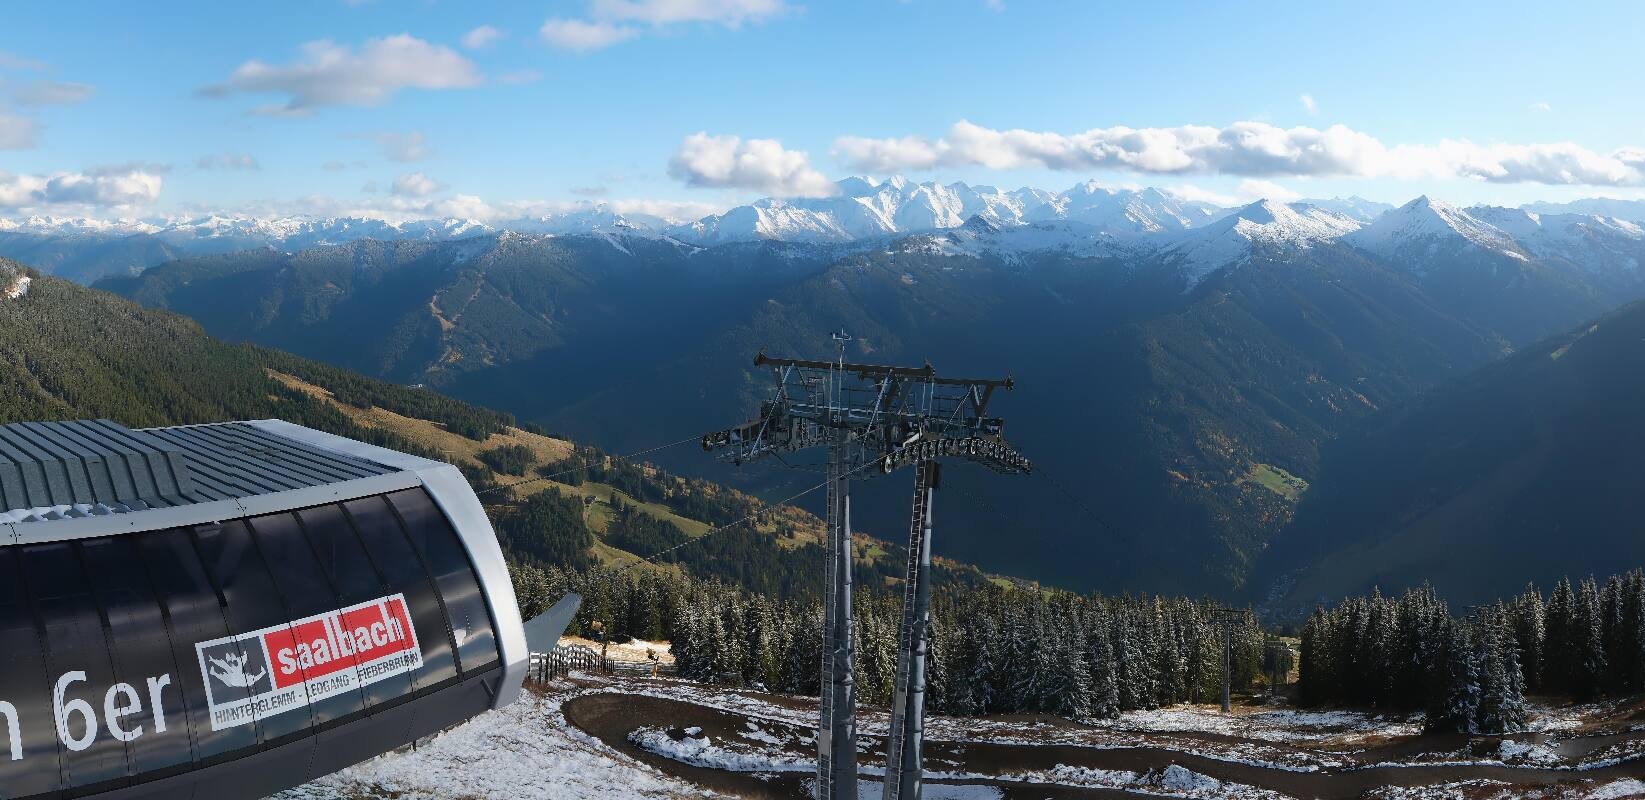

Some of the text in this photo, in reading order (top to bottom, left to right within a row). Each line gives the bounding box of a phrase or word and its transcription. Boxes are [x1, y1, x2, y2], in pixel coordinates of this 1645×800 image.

[277, 602, 405, 676] saalbach
[53, 670, 171, 751] 6er
[214, 690, 296, 723] HINTERGLEMM
[307, 674, 350, 699] LEOGANG
[357, 651, 419, 683] FIEBERBRUNN
